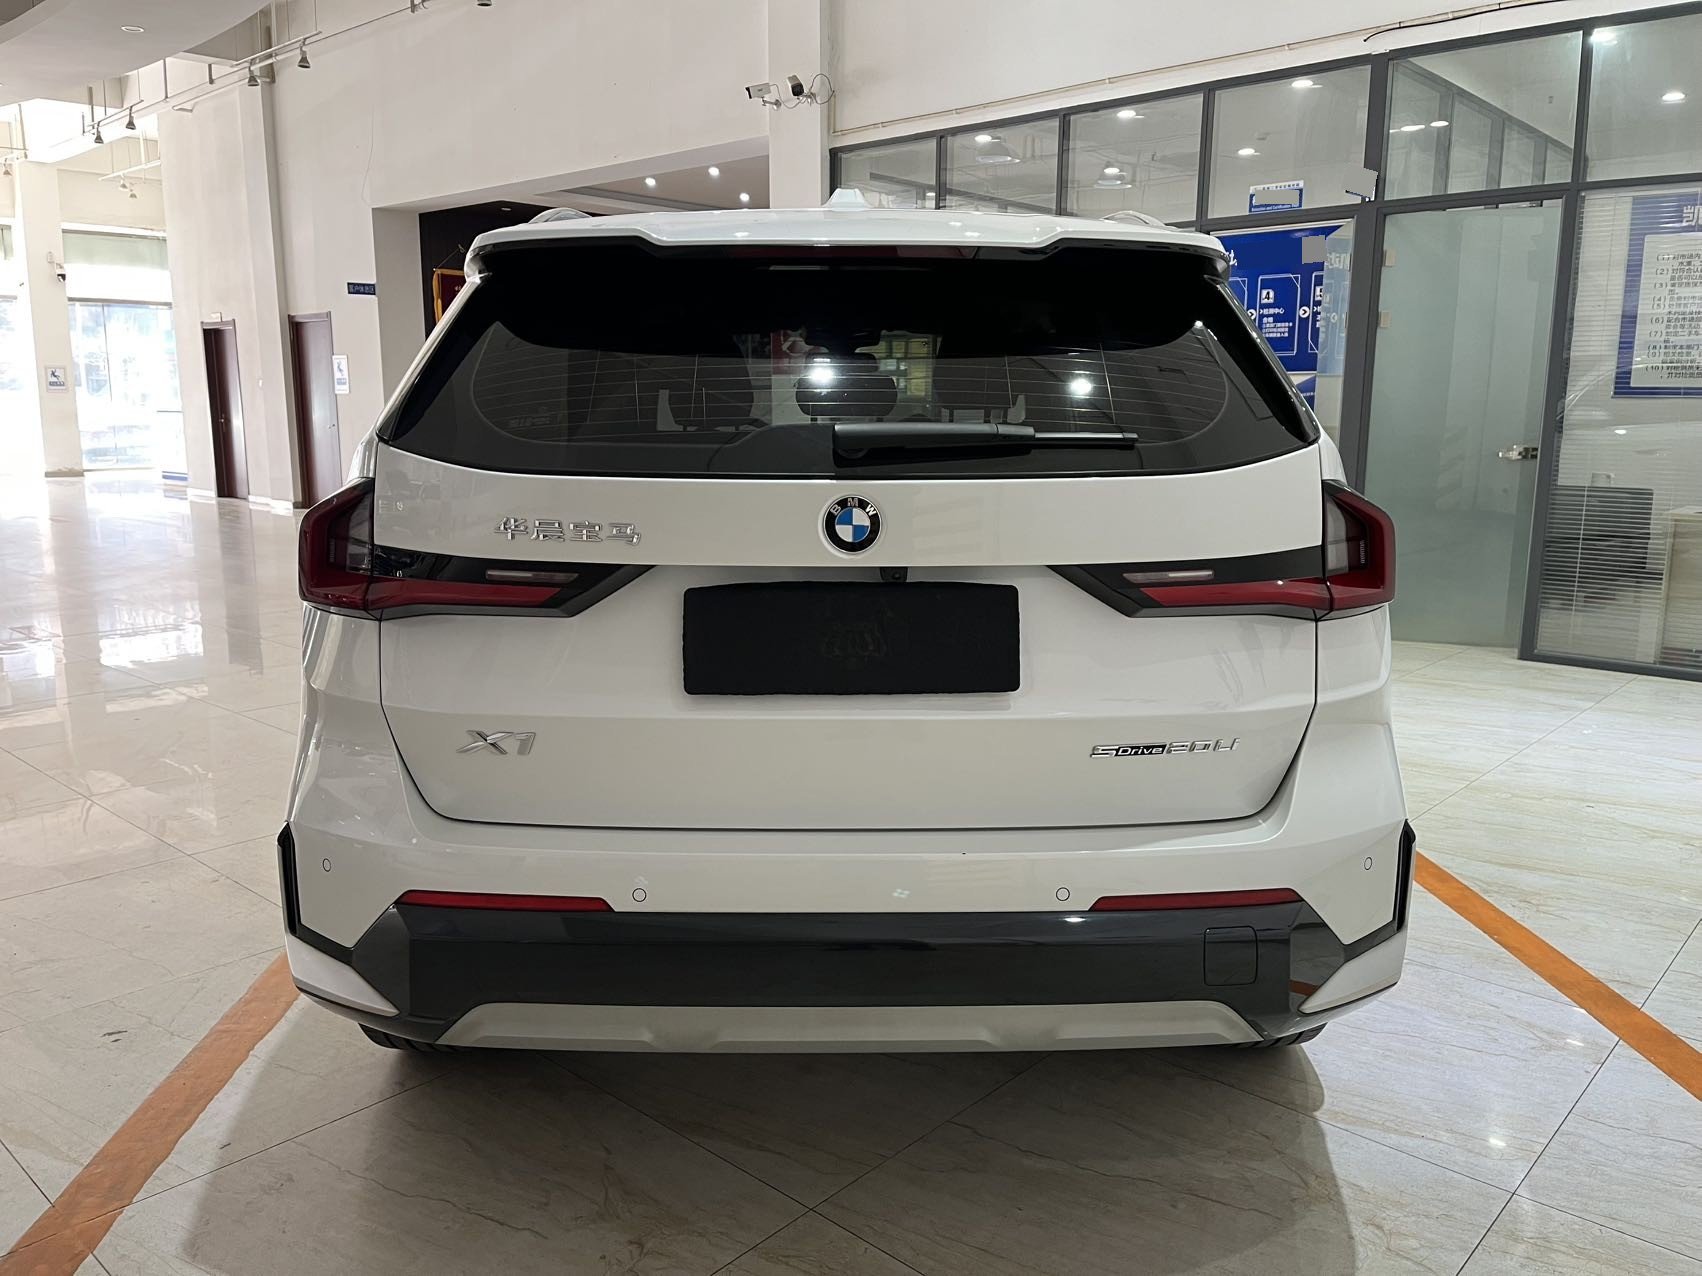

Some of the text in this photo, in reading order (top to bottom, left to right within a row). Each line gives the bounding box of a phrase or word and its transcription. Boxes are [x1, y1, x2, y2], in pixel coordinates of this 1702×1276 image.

[494, 515, 643, 547] 华晨宝马
[455, 729, 537, 756] X1
